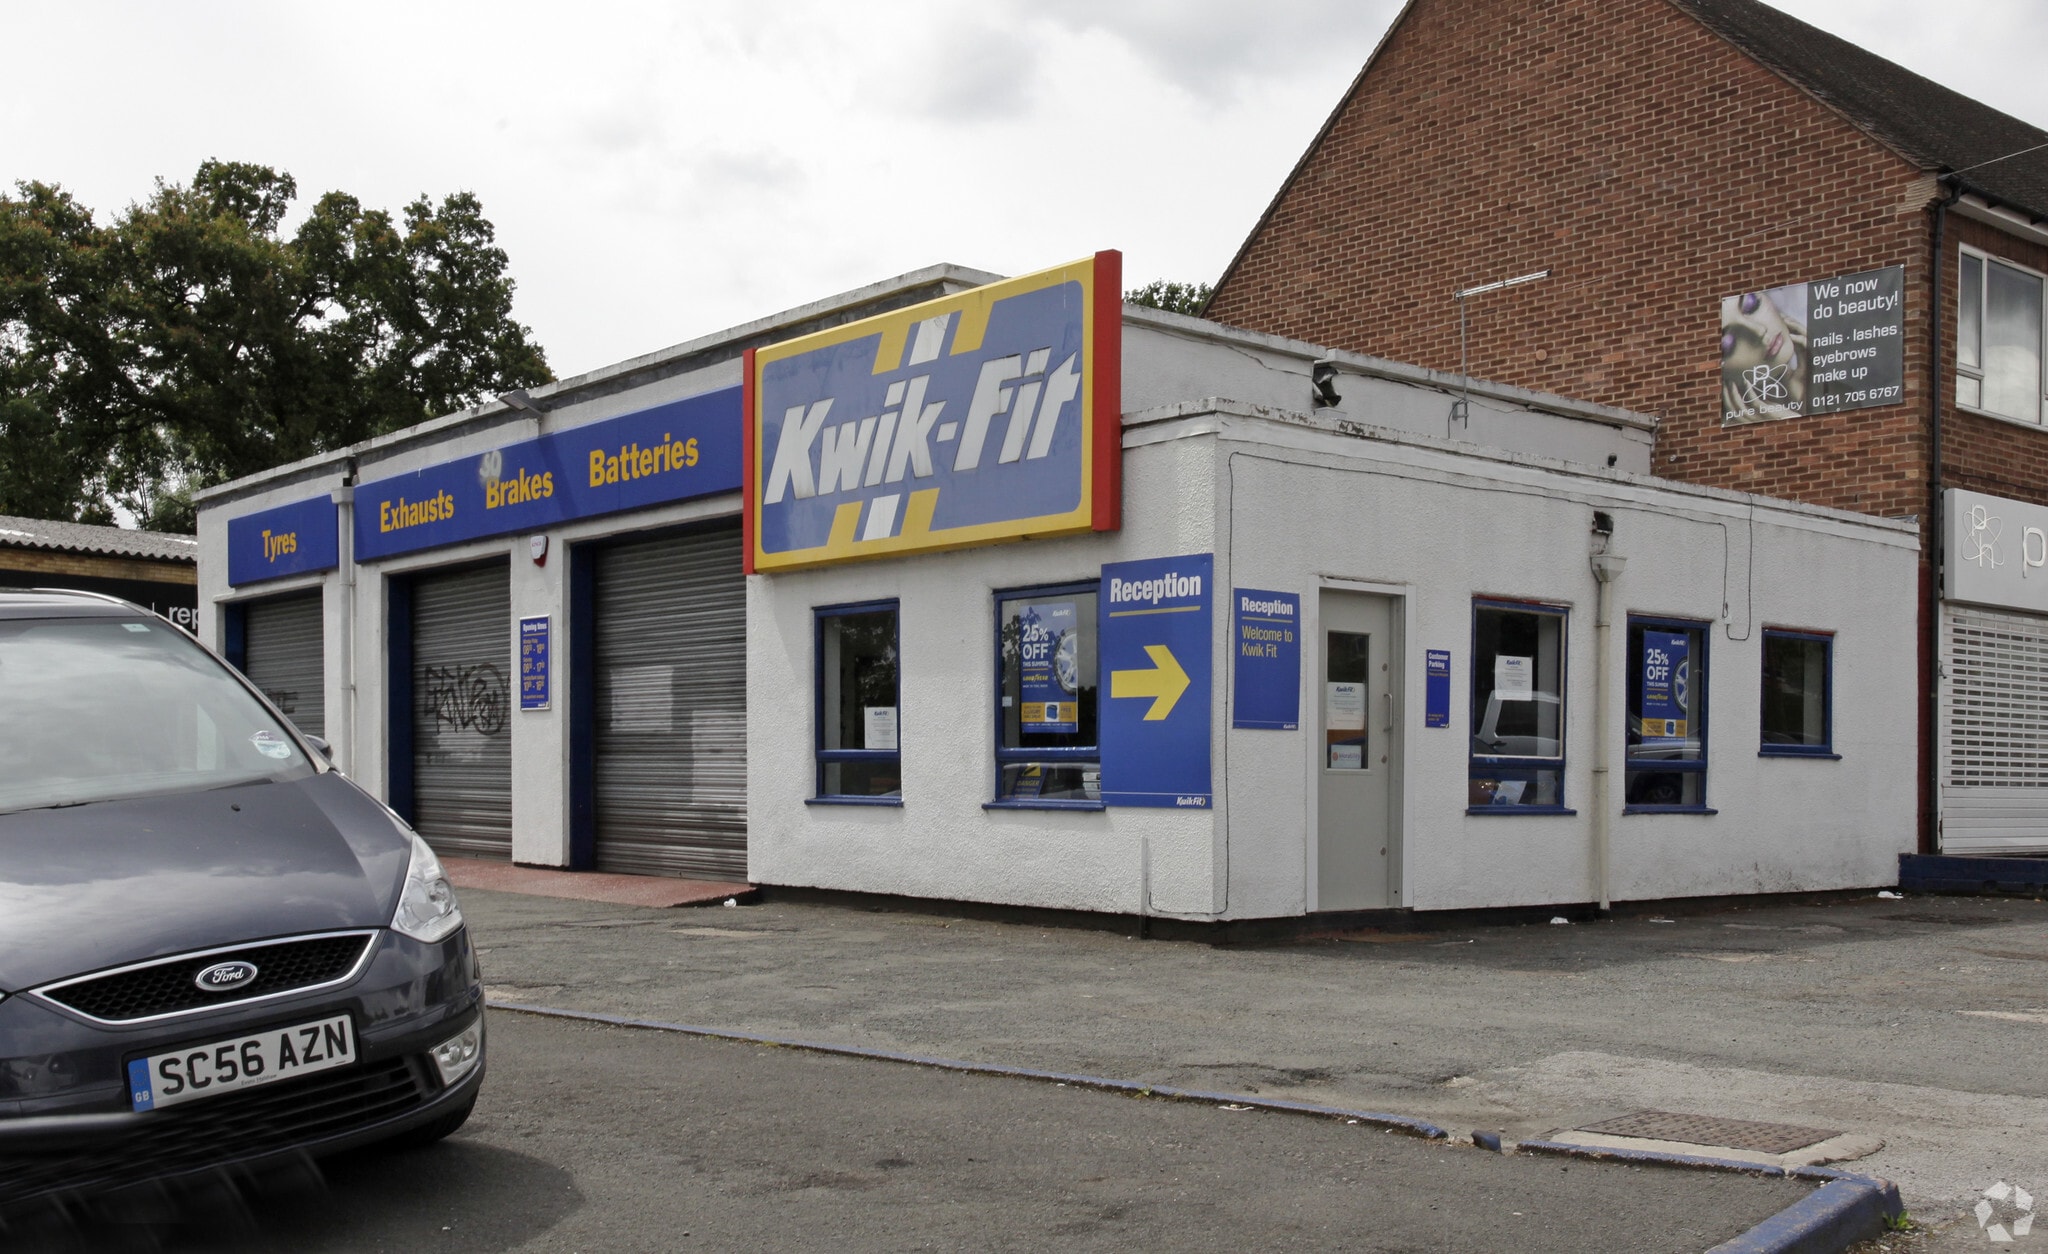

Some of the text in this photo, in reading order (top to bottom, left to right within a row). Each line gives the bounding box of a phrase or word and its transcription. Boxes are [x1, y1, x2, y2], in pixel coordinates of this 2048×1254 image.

[1814, 278, 1878, 300] We now
[1814, 291, 1898, 320] do beauty!
[1813, 325, 1897, 347] nails lashes
[1813, 347, 1877, 367] eyebrows
[1813, 367, 1868, 383] make up
[1813, 386, 1899, 407] 0121 705 6767
[1726, 400, 1803, 420] pure beauty
[763, 347, 1081, 505] Kwik-Fit
[589, 433, 699, 489] Batteries
[486, 467, 554, 510] Brakes
[381, 490, 454, 533] Exhausts
[262, 530, 296, 562] Tyres
[1110, 573, 1201, 604] Reception
[1241, 597, 1293, 616] Reception
[1023, 624, 1049, 642] 25%
[1242, 625, 1293, 643] Welcome to
[1023, 643, 1049, 660] OFF
[1242, 643, 1277, 658] Kwik Fit
[1647, 648, 1669, 665] 25%
[1647, 666, 1669, 680] OFF
[212, 967, 244, 983] Ford
[159, 1021, 349, 1096] SC56 AZN
[135, 1090, 150, 1103] GB
